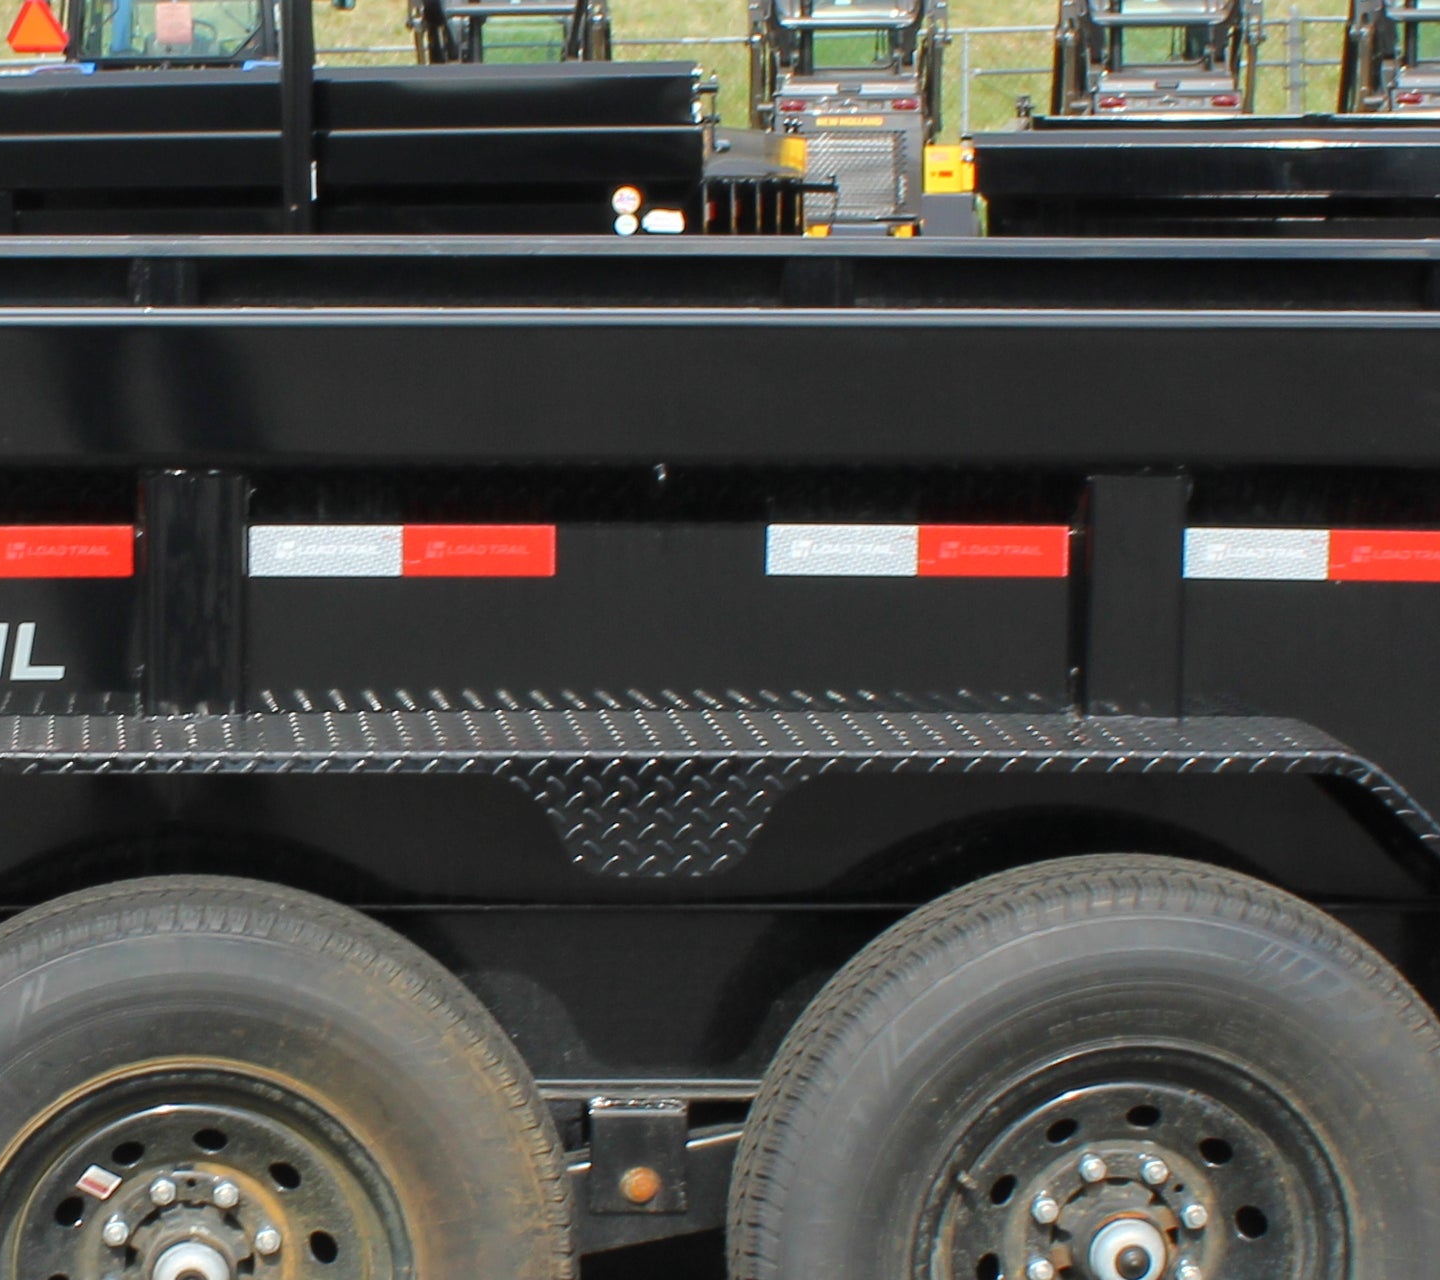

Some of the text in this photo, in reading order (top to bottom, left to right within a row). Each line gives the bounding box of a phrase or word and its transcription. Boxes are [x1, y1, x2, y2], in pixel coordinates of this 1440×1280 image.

[27, 545, 112, 556] LOAD TRAIL
[295, 545, 381, 556] LOAD TRAIL
[446, 544, 531, 555] LOAD TRAIL
[811, 544, 896, 555] LOAD TRAIL
[960, 544, 1045, 556] LOAD TRAIL
[1225, 548, 1308, 559] LOAD TRAIL
[1372, 549, 1412, 560] LOAD
